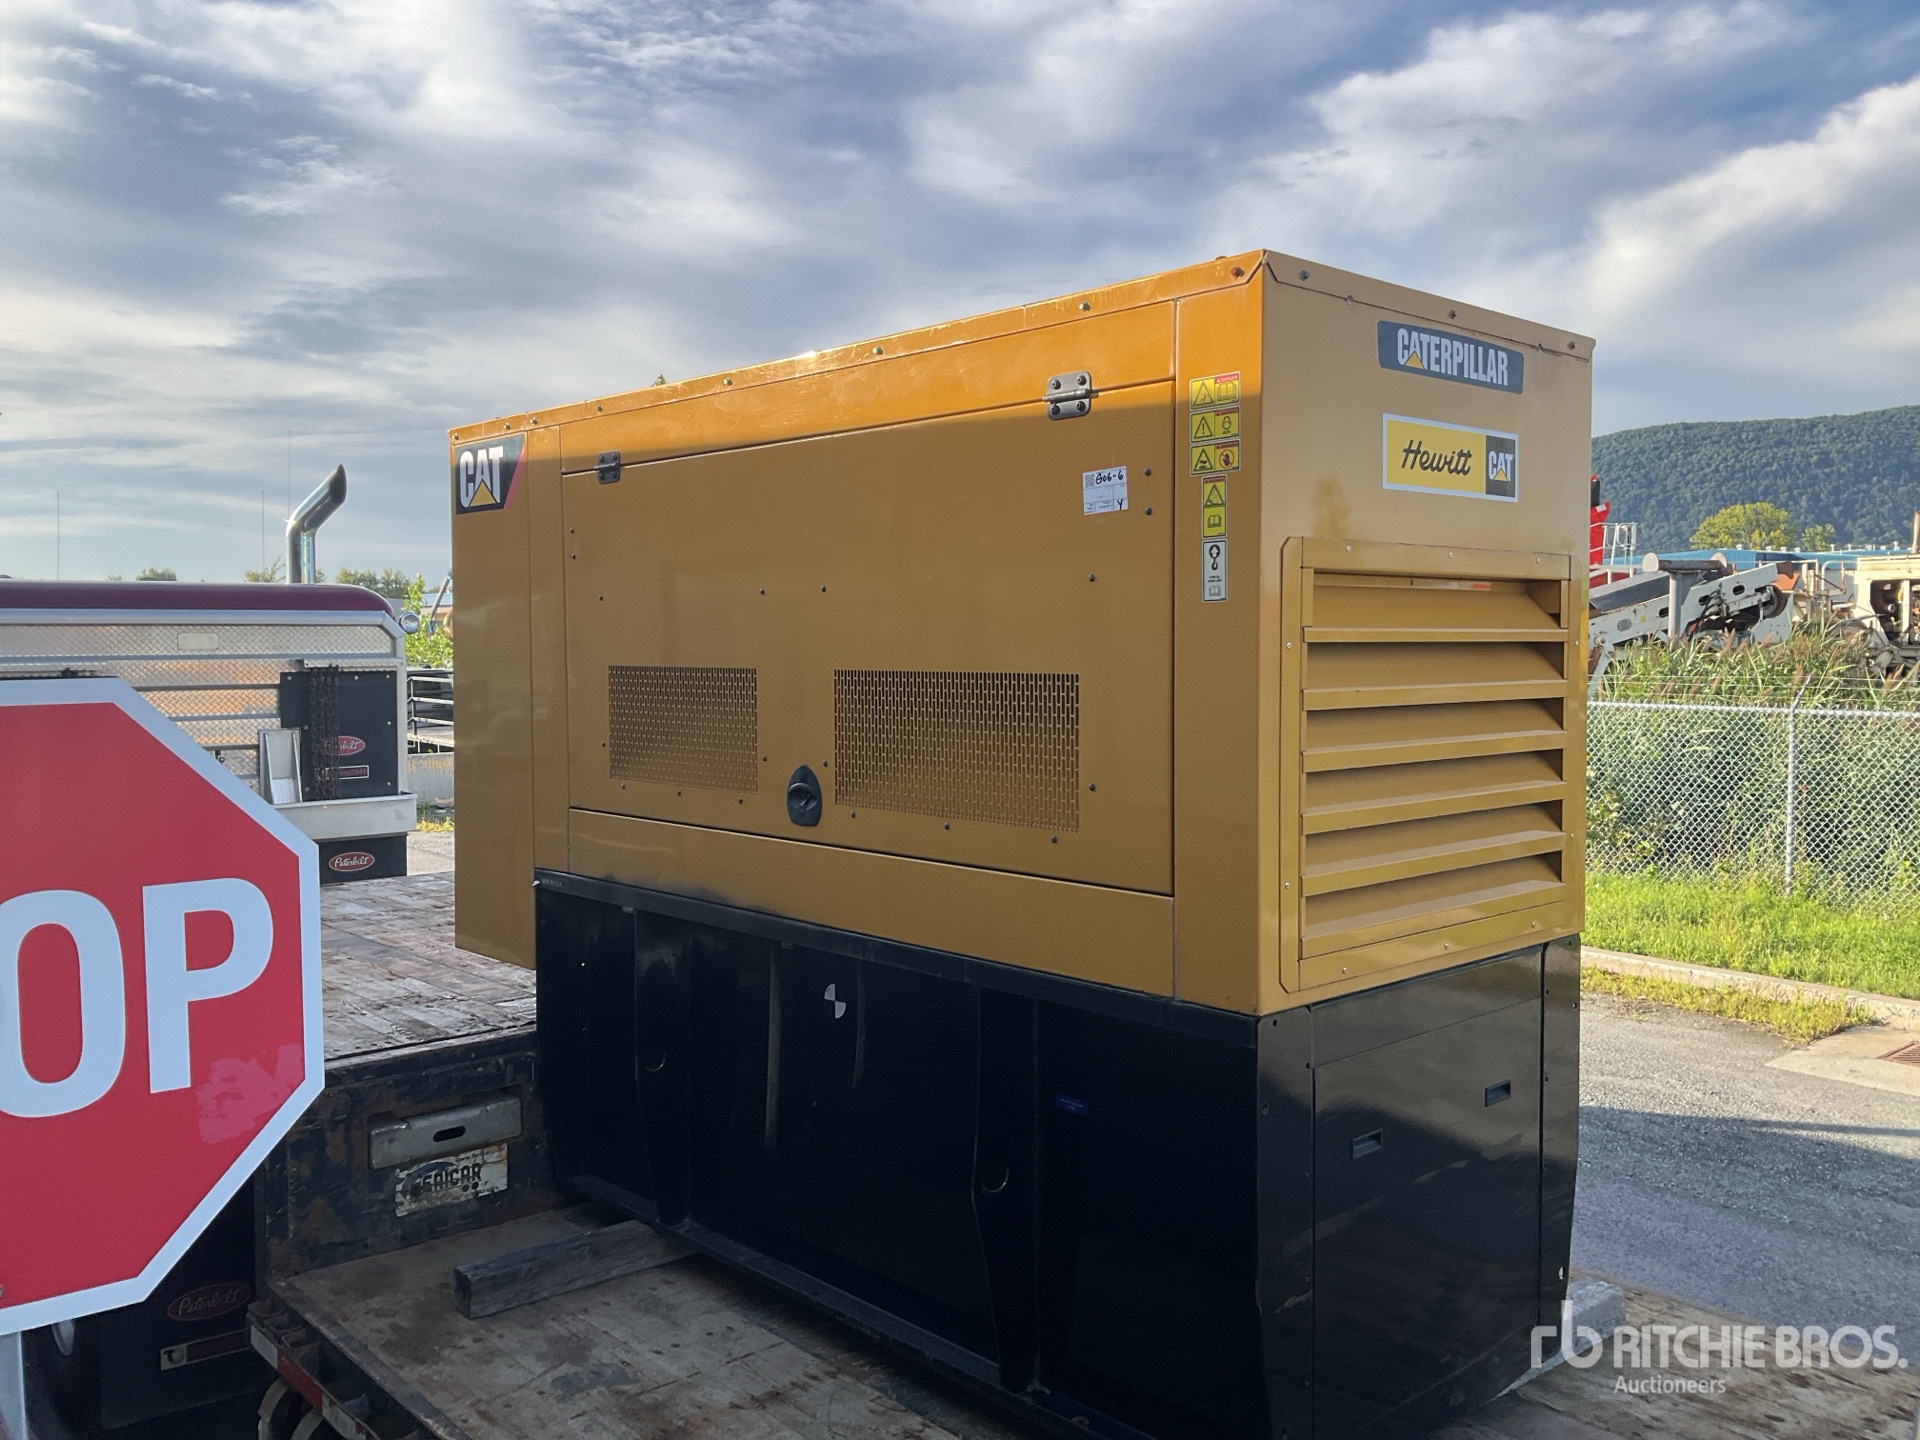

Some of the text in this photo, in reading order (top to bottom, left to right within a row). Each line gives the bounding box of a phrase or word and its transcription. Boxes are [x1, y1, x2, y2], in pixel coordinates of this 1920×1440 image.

[1397, 328, 1508, 386] CATERPILLAR
[459, 445, 504, 508] CAT
[1401, 439, 1513, 482] Hewitt CAT
[334, 856, 371, 868] Peterbilt
[409, 1162, 482, 1199] ERICAR
[178, 1288, 242, 1317] Peterbilt
